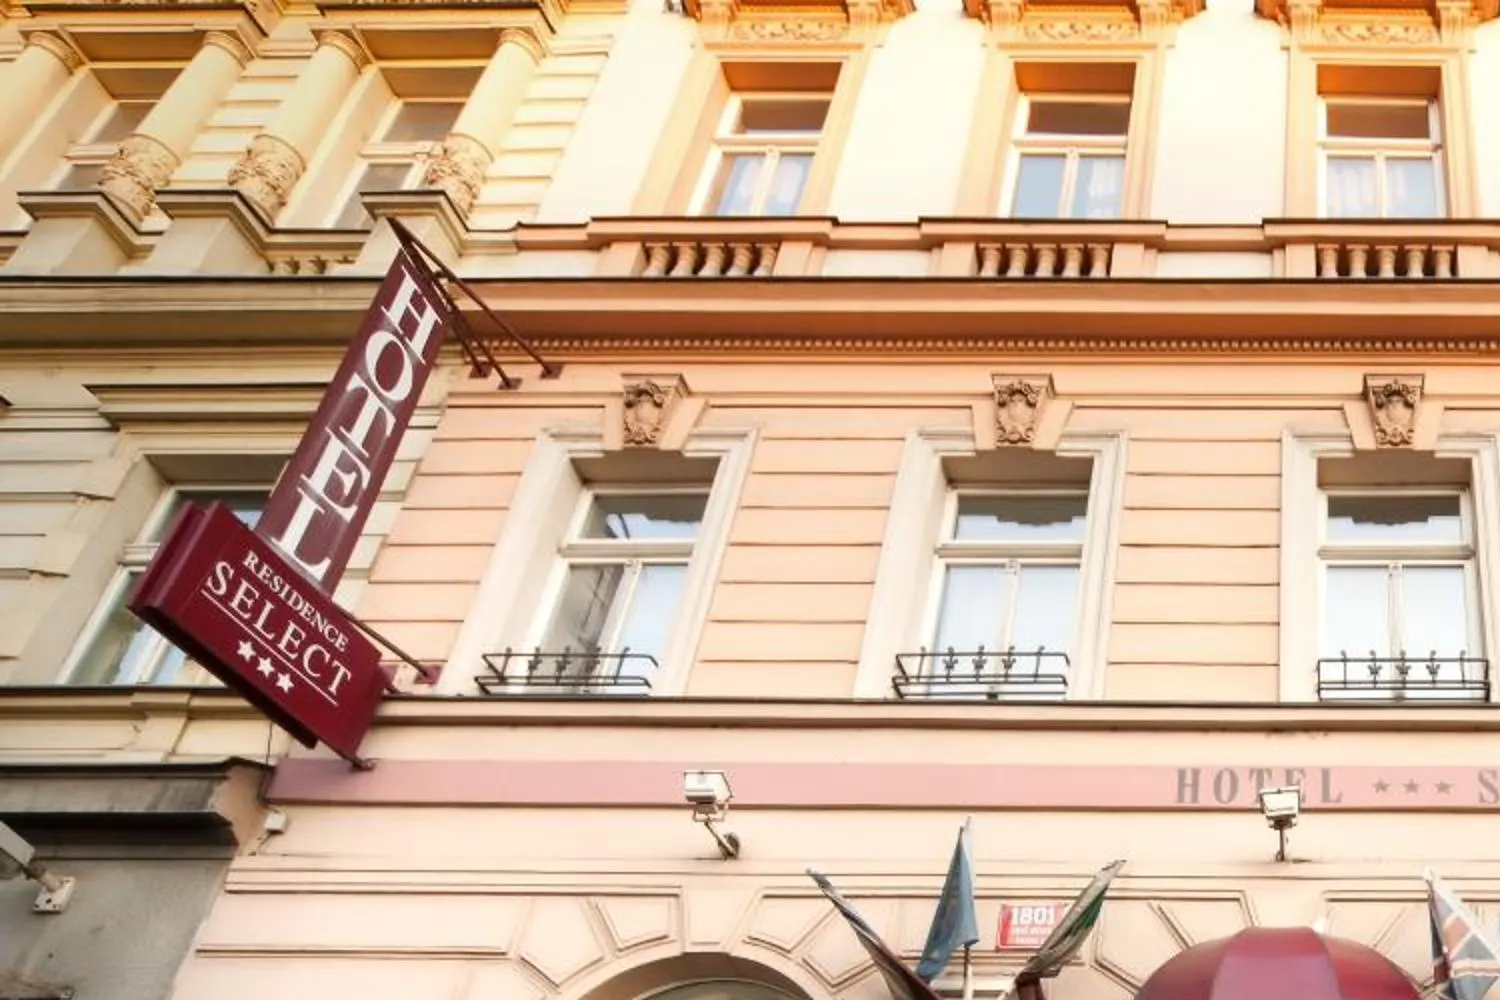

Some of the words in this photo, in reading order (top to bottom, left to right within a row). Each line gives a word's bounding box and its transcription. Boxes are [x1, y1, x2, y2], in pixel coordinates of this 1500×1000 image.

[271, 263, 442, 582] HOTEL
[206, 561, 352, 695] SELECT
[243, 550, 349, 652] RESIDENCE
[1012, 906, 1056, 925] 1801
